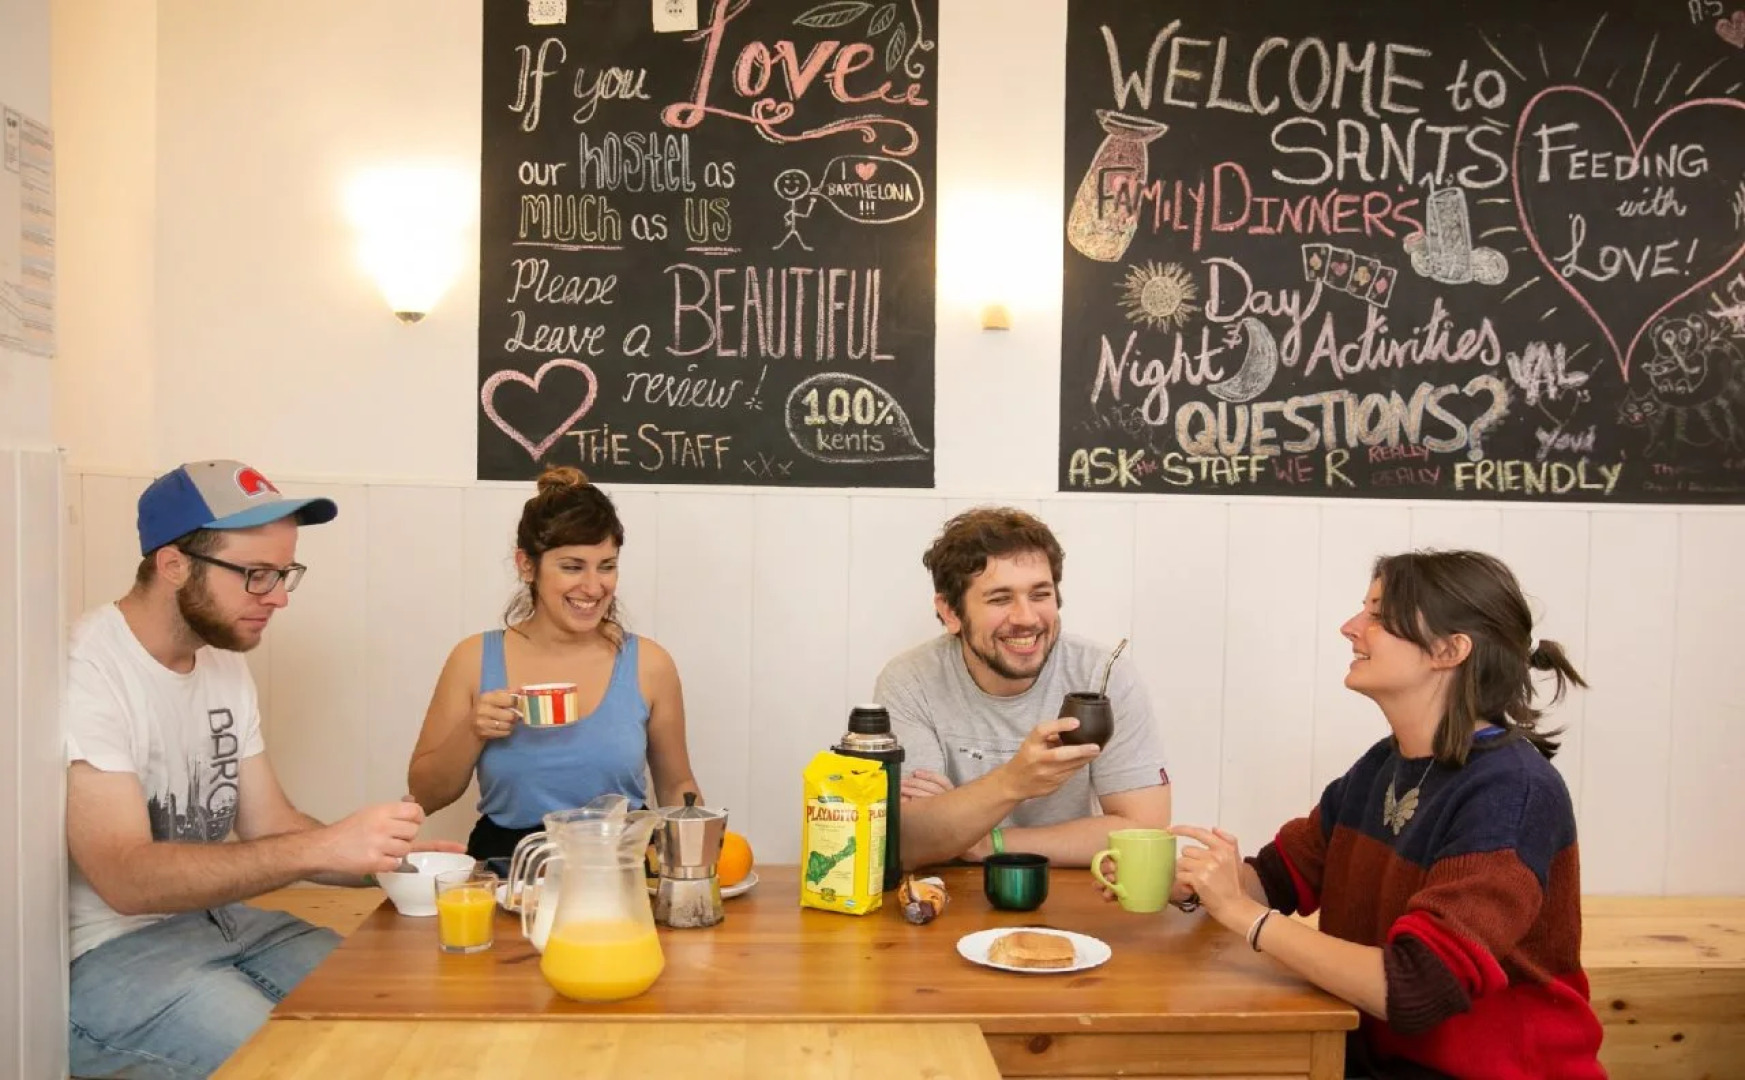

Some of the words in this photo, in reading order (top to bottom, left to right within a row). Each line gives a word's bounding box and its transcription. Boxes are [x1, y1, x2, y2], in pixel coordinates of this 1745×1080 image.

[508, 37, 567, 132] If
[573, 66, 651, 124] you
[661, 0, 928, 128] Love
[1100, 18, 1433, 118] WELCOME
[1445, 60, 1507, 111] to
[518, 161, 567, 187] our
[704, 161, 735, 189] as
[841, 161, 846, 181] I
[1271, 117, 1509, 189] SANTS
[1533, 122, 1708, 182] FEEDING
[828, 182, 915, 202] BARTHELONA
[1616, 186, 1688, 217] with
[631, 213, 668, 242] as
[507, 258, 618, 305] Please
[504, 310, 606, 356] Leave
[622, 324, 651, 358] a
[663, 262, 895, 362] BEAUTIFUL
[1201, 257, 1323, 367] Day
[1091, 326, 1225, 425] Night
[1304, 296, 1500, 380] Activities
[801, 387, 894, 426] 100%
[1175, 374, 1509, 461] QUESTIONS?
[565, 423, 631, 465] THE
[637, 423, 732, 473] STAFF
[1069, 447, 1146, 487] ASK
[1161, 452, 1269, 487] STAFF
[1271, 456, 1315, 484] WE
[1325, 449, 1355, 487] R
[1455, 458, 1624, 494] FRIENDLY
